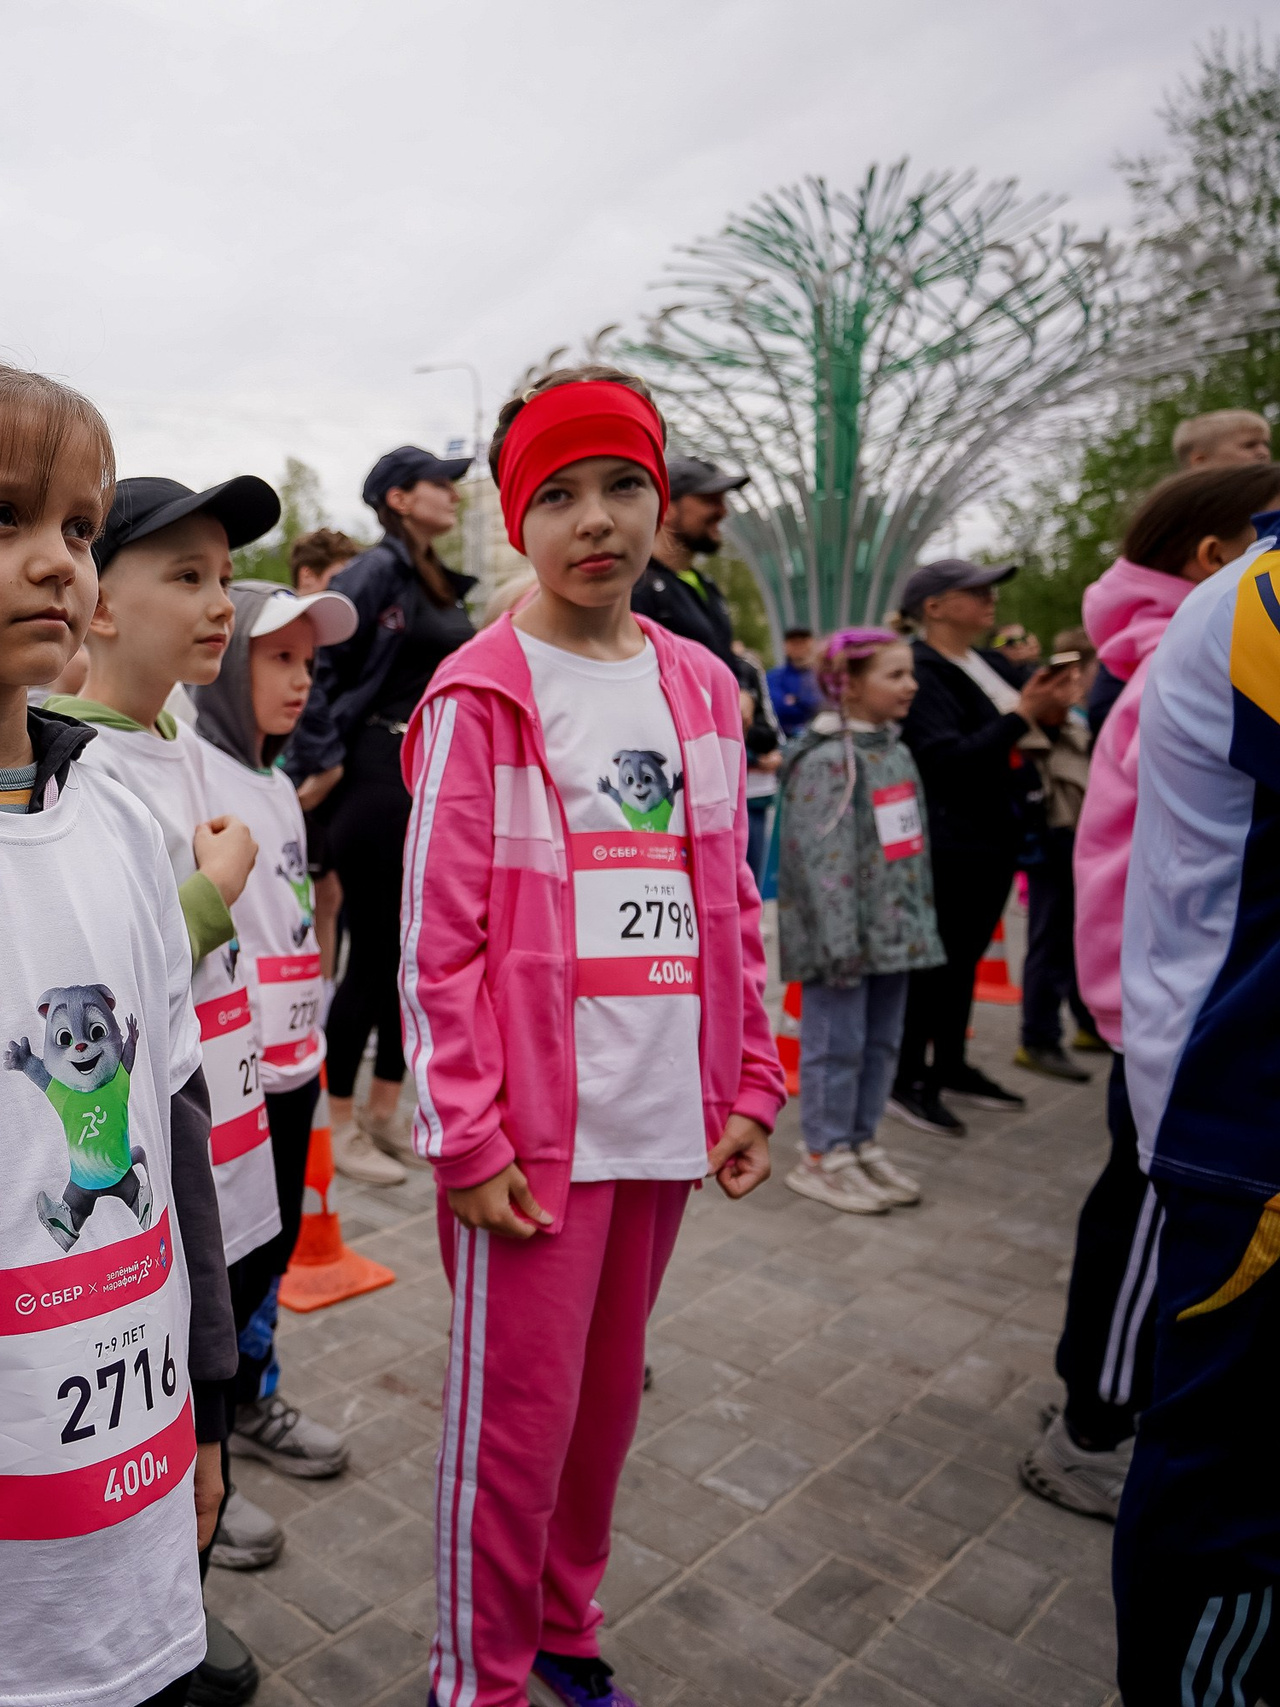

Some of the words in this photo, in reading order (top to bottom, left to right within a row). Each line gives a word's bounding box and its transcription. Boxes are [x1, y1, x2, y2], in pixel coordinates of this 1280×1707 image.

[619, 901, 694, 940] 2798
[102, 1274, 137, 1292] марафон
[106, 1260, 140, 1282] зелёный
[40, 1285, 83, 1307] СБЕР
[95, 1337, 117, 1358] 7-9
[122, 1323, 146, 1348] ЛЕТ
[57, 1332, 177, 1444] 2716
[103, 1451, 169, 1503] 400м
